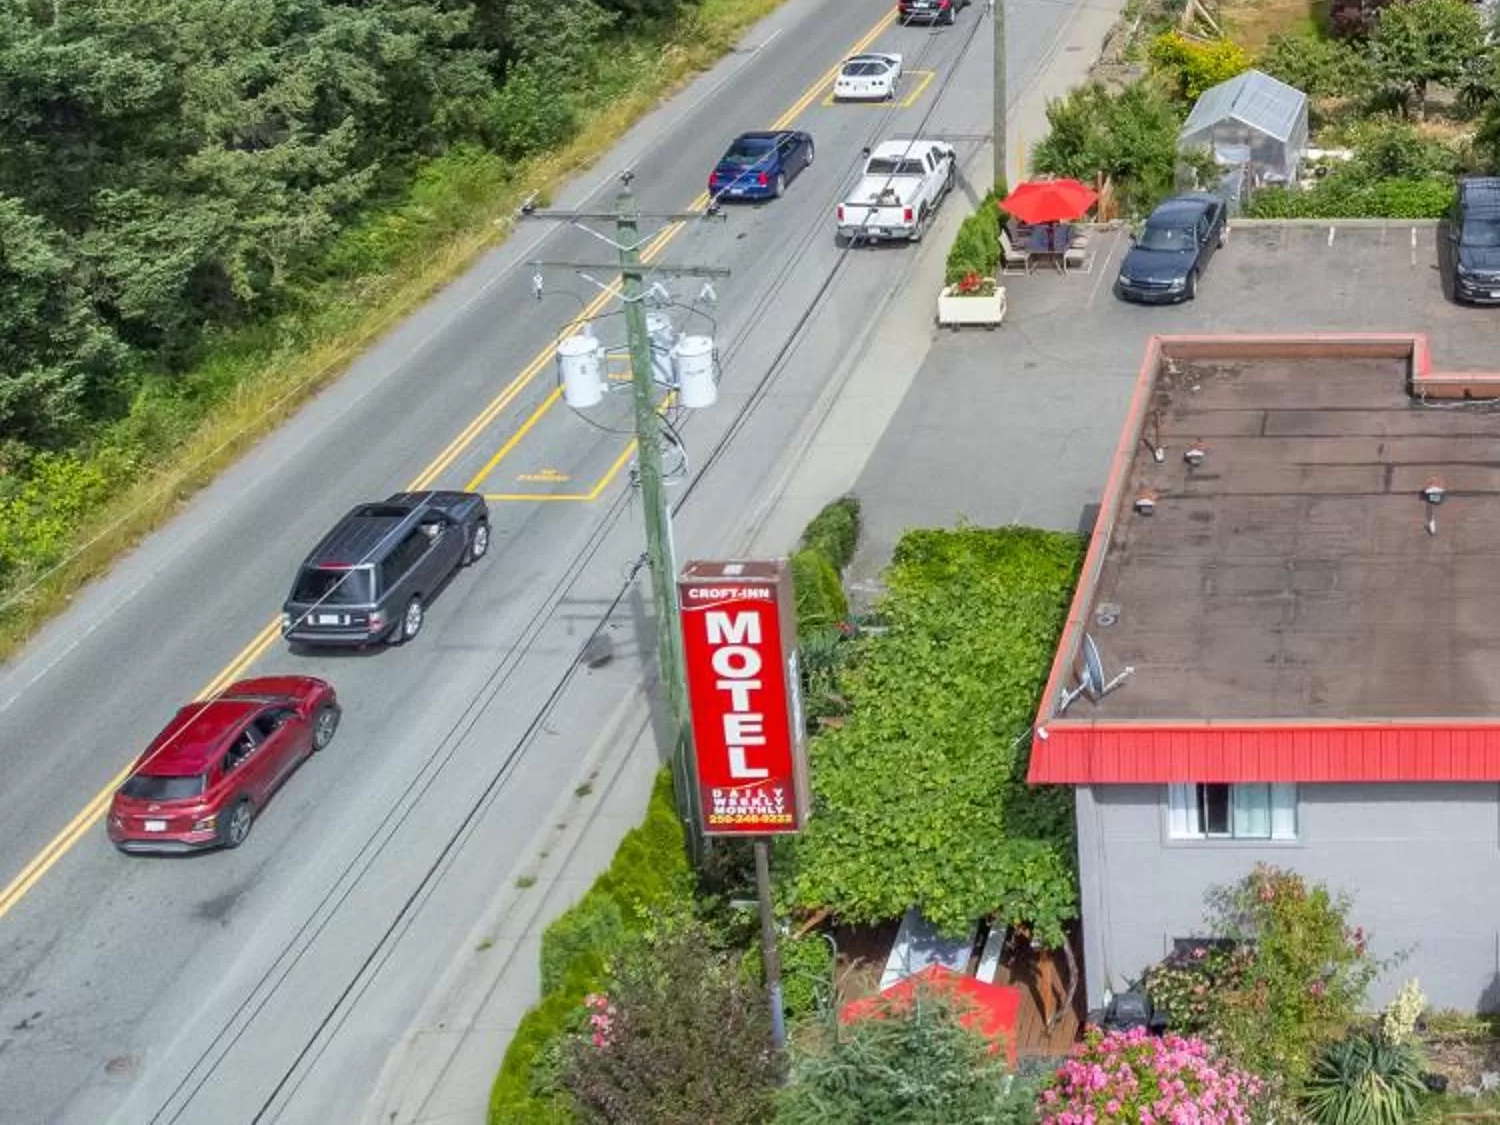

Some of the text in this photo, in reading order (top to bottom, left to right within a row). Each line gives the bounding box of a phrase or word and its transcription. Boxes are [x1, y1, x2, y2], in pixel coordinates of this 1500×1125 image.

[688, 588, 769, 599] CROFT-INN
[705, 611, 768, 778] MOTEL
[712, 788, 783, 797] DAILY
[713, 797, 784, 806] WEEKLY
[714, 806, 785, 814] MONTHLY
